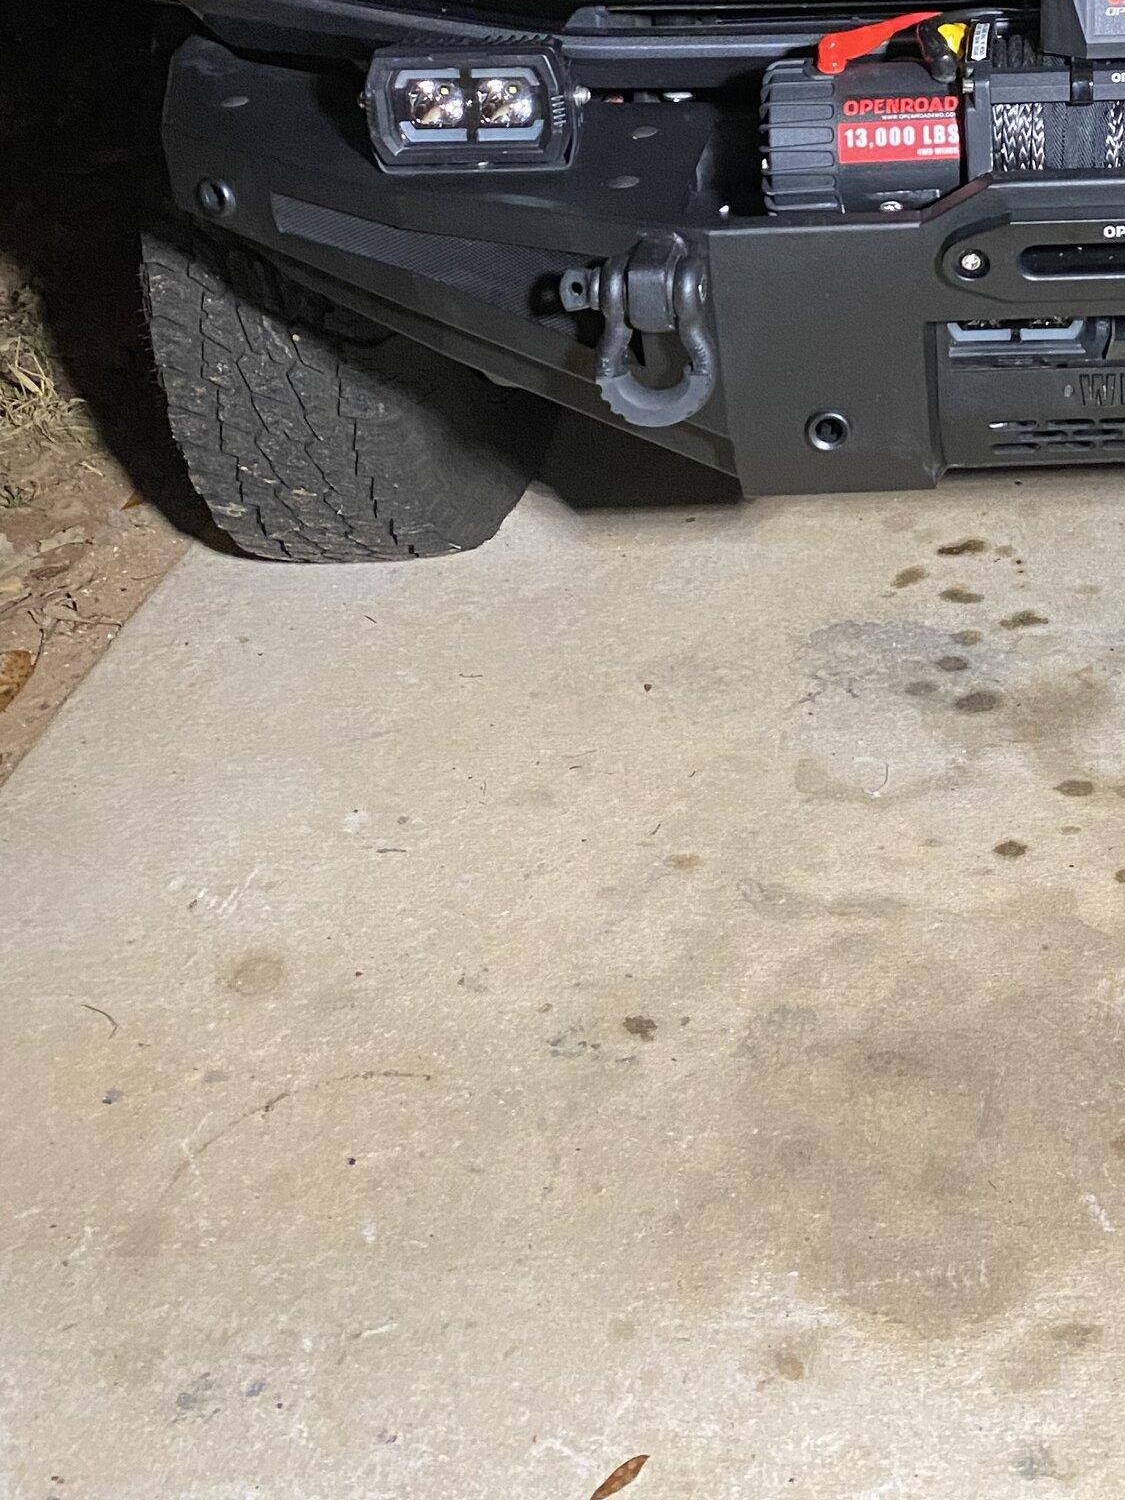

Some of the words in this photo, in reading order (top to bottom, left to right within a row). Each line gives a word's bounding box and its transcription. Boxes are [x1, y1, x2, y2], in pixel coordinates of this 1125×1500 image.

[843, 96, 958, 116] OPENROAD
[844, 126, 915, 149] 13,000
[923, 124, 959, 145] LBS
